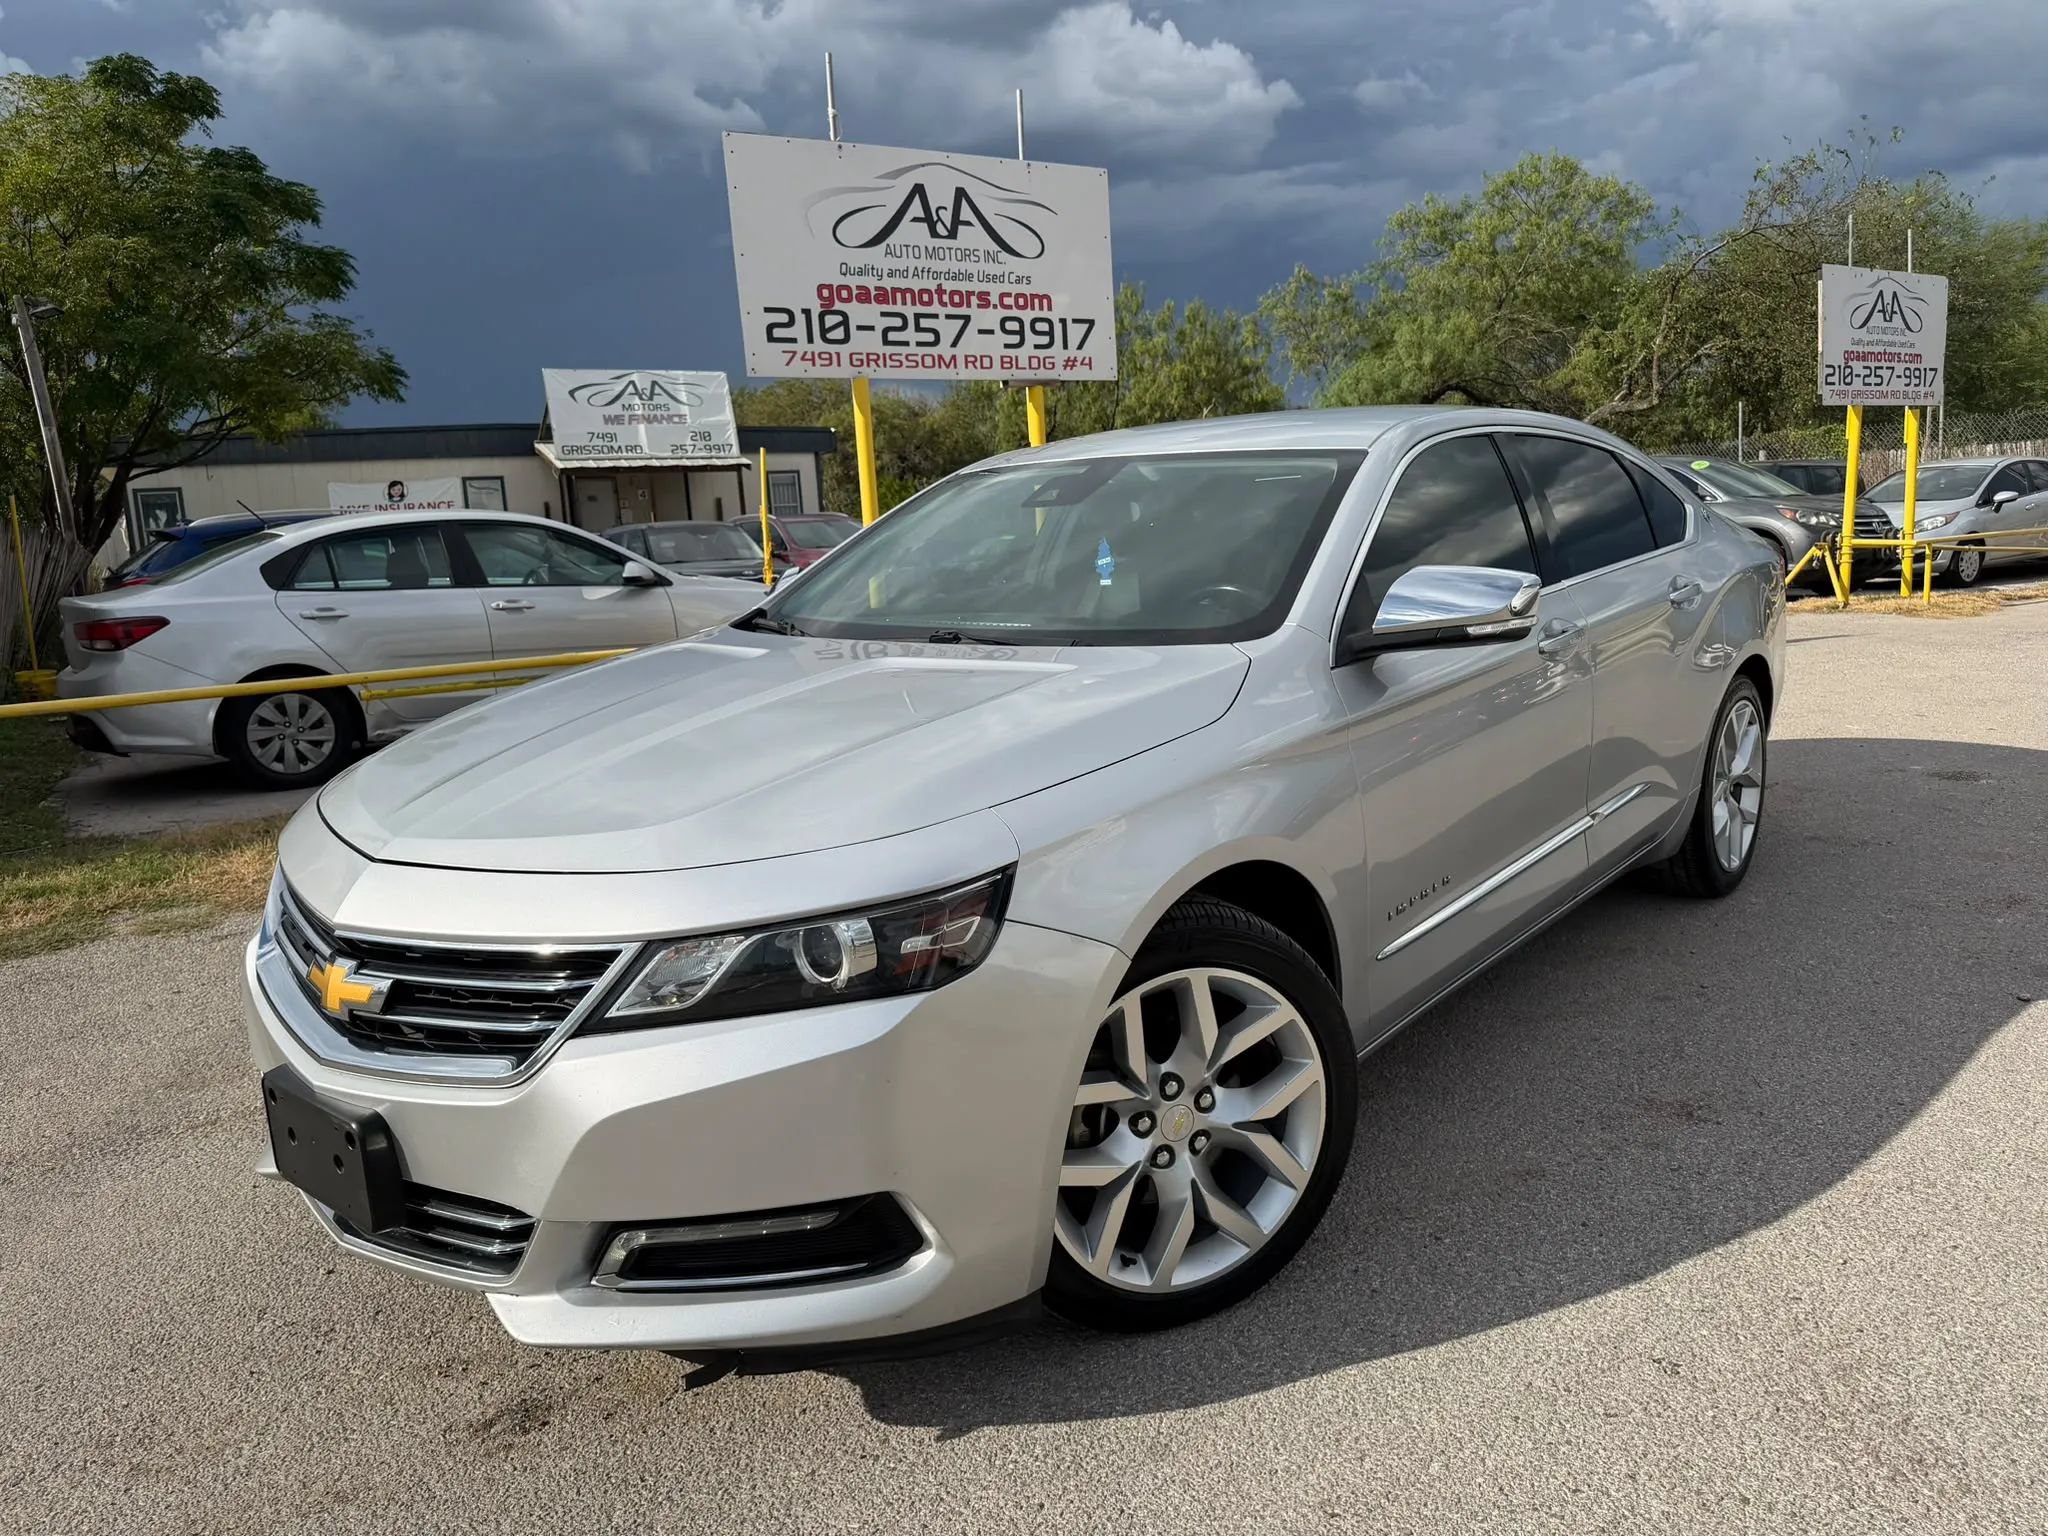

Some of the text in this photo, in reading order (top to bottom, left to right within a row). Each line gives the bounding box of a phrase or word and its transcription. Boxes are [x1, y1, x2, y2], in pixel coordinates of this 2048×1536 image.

[884, 243, 1007, 265] AUTO MOTORS INC.
[839, 262, 1032, 285] Quality and Affordable Used Cars
[816, 282, 1054, 312] goaamotors.com
[763, 306, 1096, 351] 210-257-9917
[782, 350, 1093, 371] 7491 GRISSOM RD BLDG #4
[1843, 348, 1922, 365] goaamotors.com
[1825, 365, 1938, 388] 210-257-9917
[1829, 389, 1935, 400] 7491 GRISSOM RD BLDG #4
[621, 403, 671, 412] MOTORS
[602, 413, 688, 426] WE FINANCE
[587, 431, 618, 443] 7491
[690, 430, 712, 442] 210
[561, 444, 623, 456] GRISSOM
[670, 443, 734, 455] 257-9917
